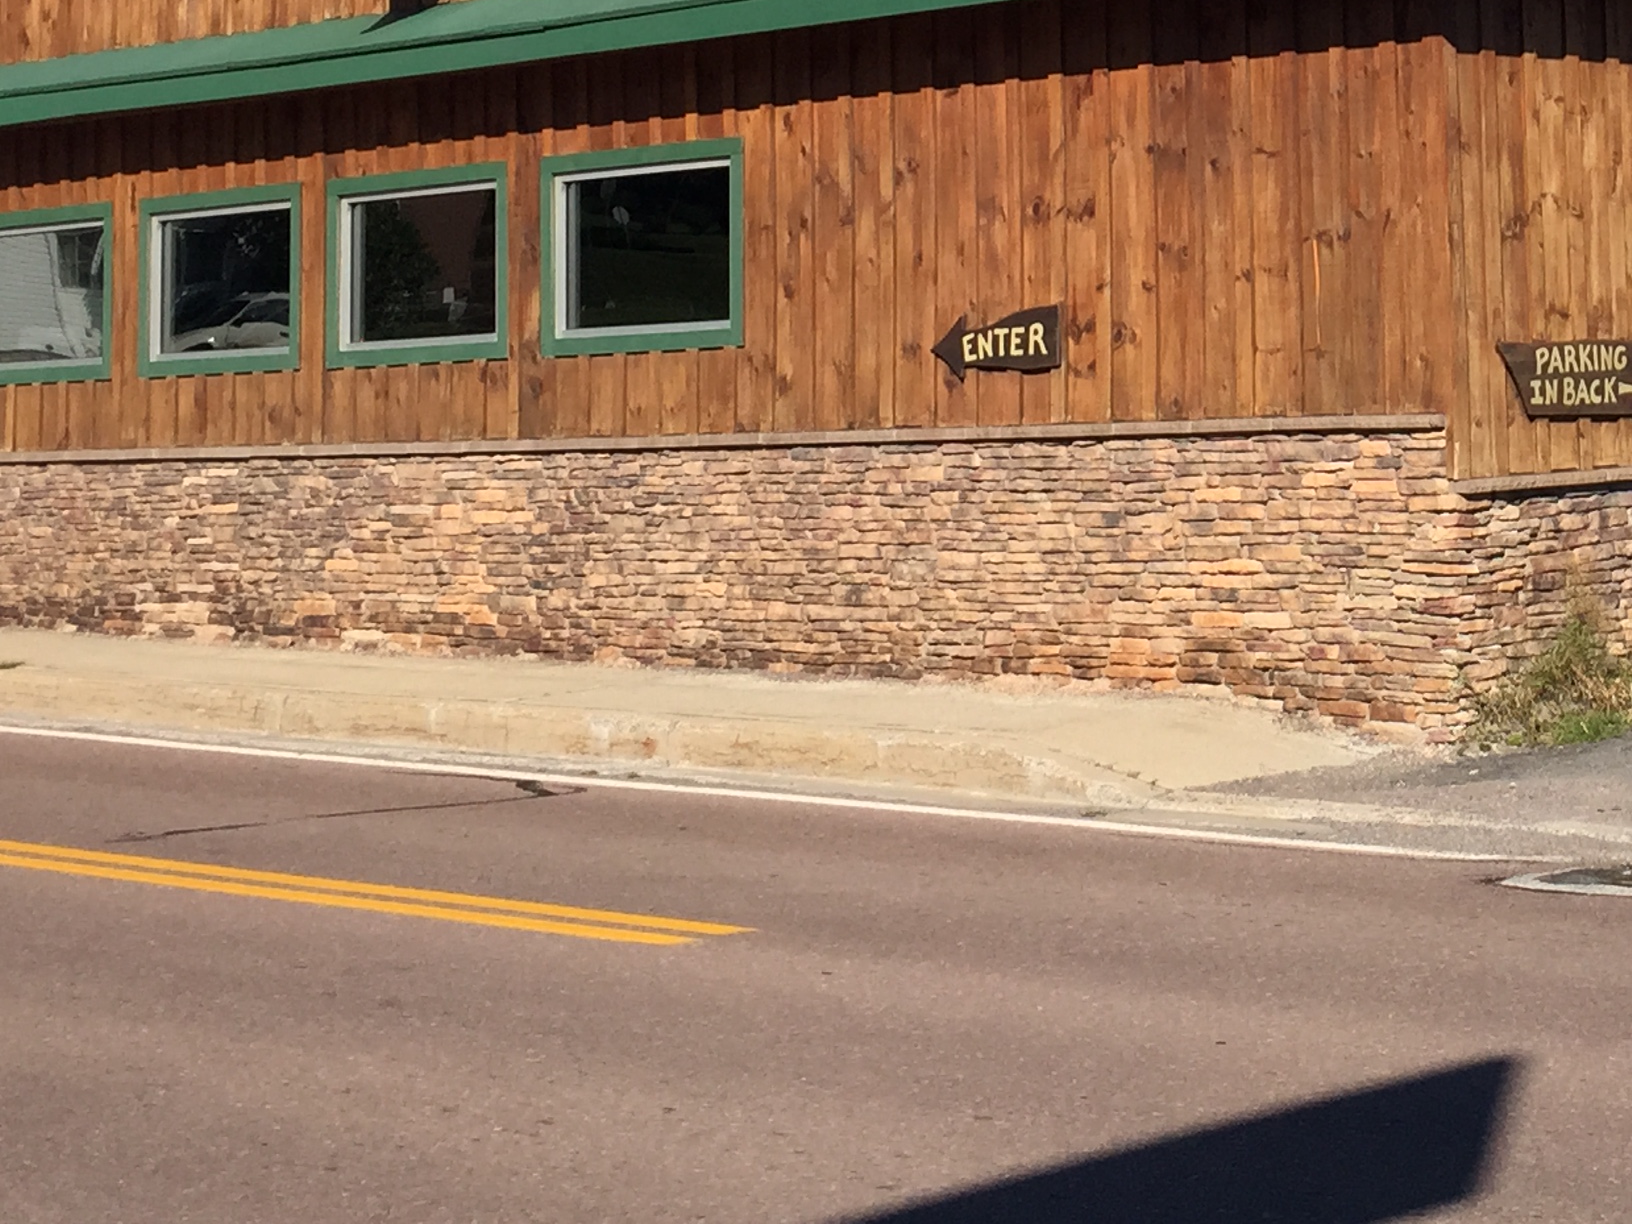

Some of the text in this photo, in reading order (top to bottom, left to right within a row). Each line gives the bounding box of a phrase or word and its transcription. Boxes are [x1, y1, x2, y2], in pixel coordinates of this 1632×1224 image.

[962, 321, 1049, 363] ENTER
[1535, 343, 1628, 375] PARKING
[1530, 376, 1618, 407] IN BACK
